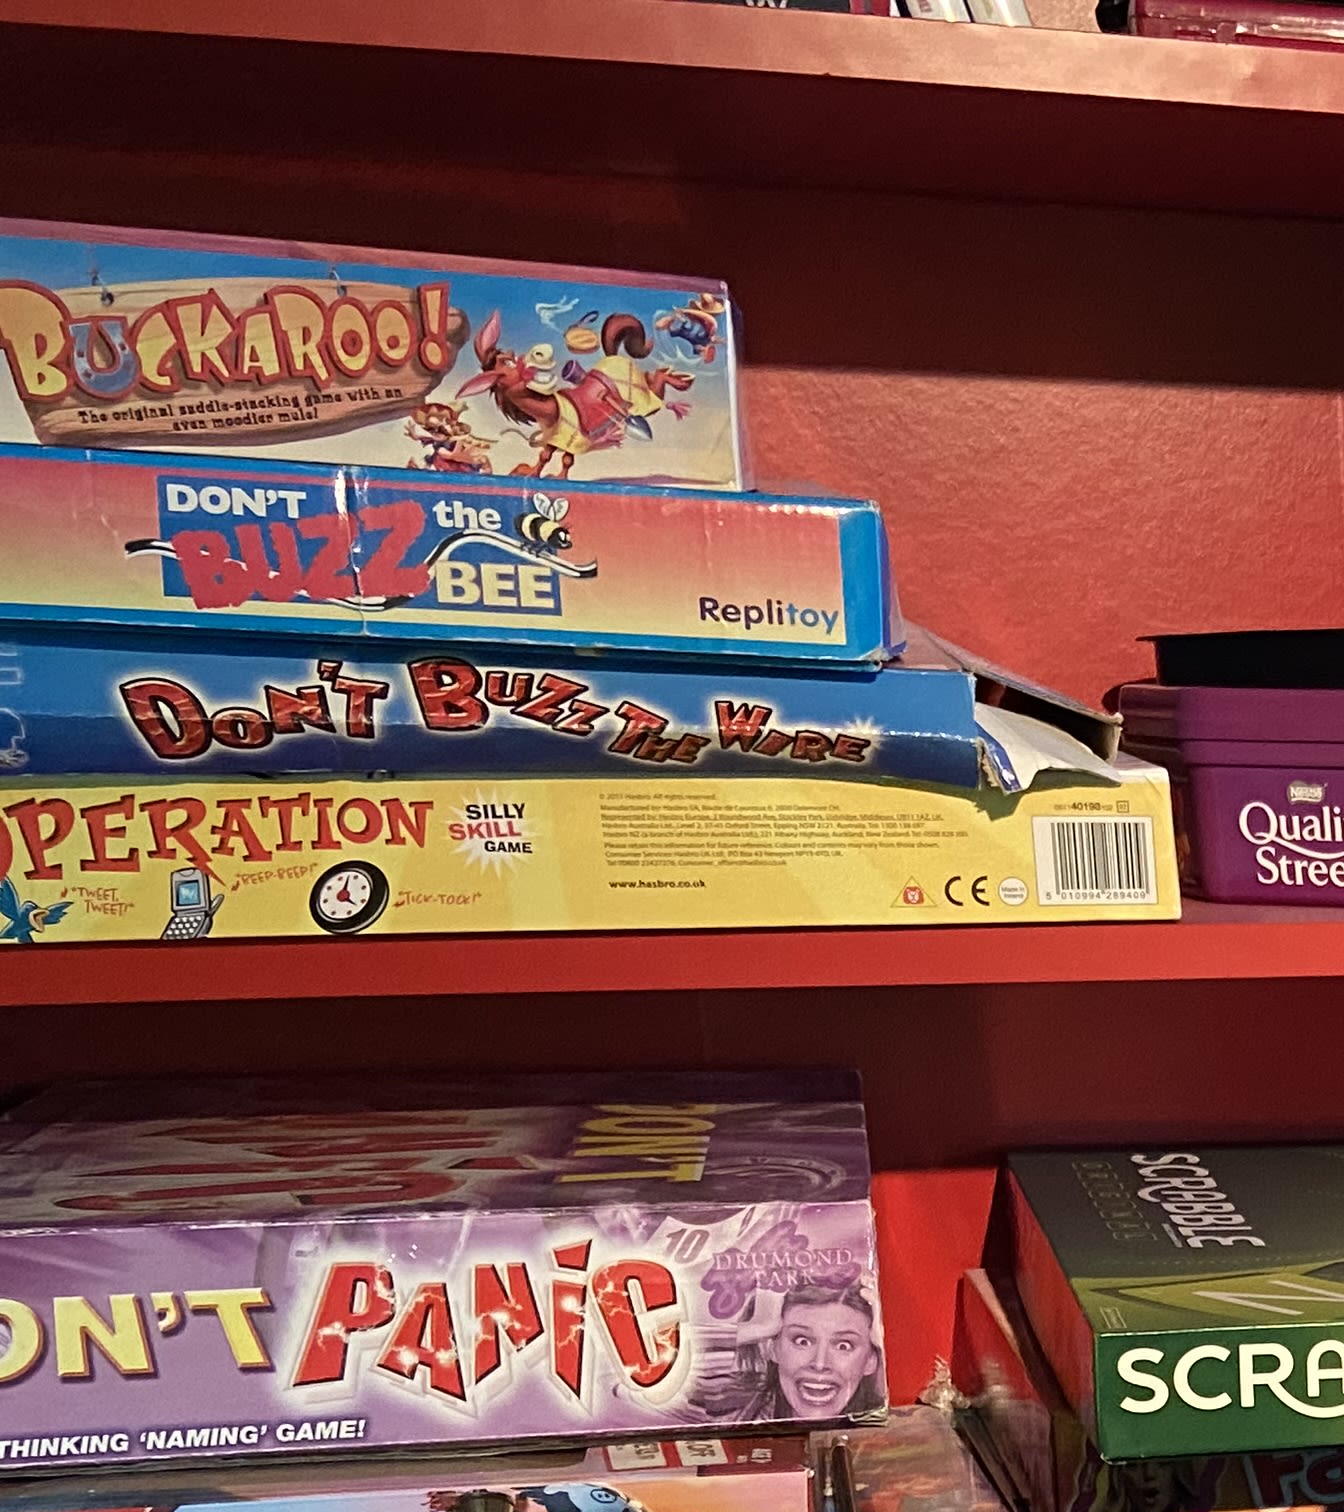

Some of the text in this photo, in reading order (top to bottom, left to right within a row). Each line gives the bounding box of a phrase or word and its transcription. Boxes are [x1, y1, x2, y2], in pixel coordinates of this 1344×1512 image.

[0, 280, 449, 401] BUCKAROO!
[78, 410, 108, 424] The
[112, 404, 173, 422] original
[304, 392, 342, 410] game
[349, 388, 381, 402] with
[384, 387, 403, 400] an
[211, 413, 273, 427] moodier
[278, 408, 319, 422] mule!
[166, 483, 306, 520] DON'T
[431, 500, 502, 531] the
[170, 500, 432, 610] BUZZ
[434, 560, 555, 609] BEE
[699, 595, 839, 638] Replitoy
[465, 803, 525, 820] SILLY
[448, 820, 522, 840] SKILL
[484, 840, 533, 854] GAME
[608, 879, 706, 889] www.hasbro.co.uk
[1130, 1153, 1267, 1248] SCRABBLE
[665, 1228, 712, 1264] 10
[715, 1249, 852, 1272] DRUMOND
[0, 1432, 129, 1459] THINKING
[276, 1419, 367, 1443] GAME!
